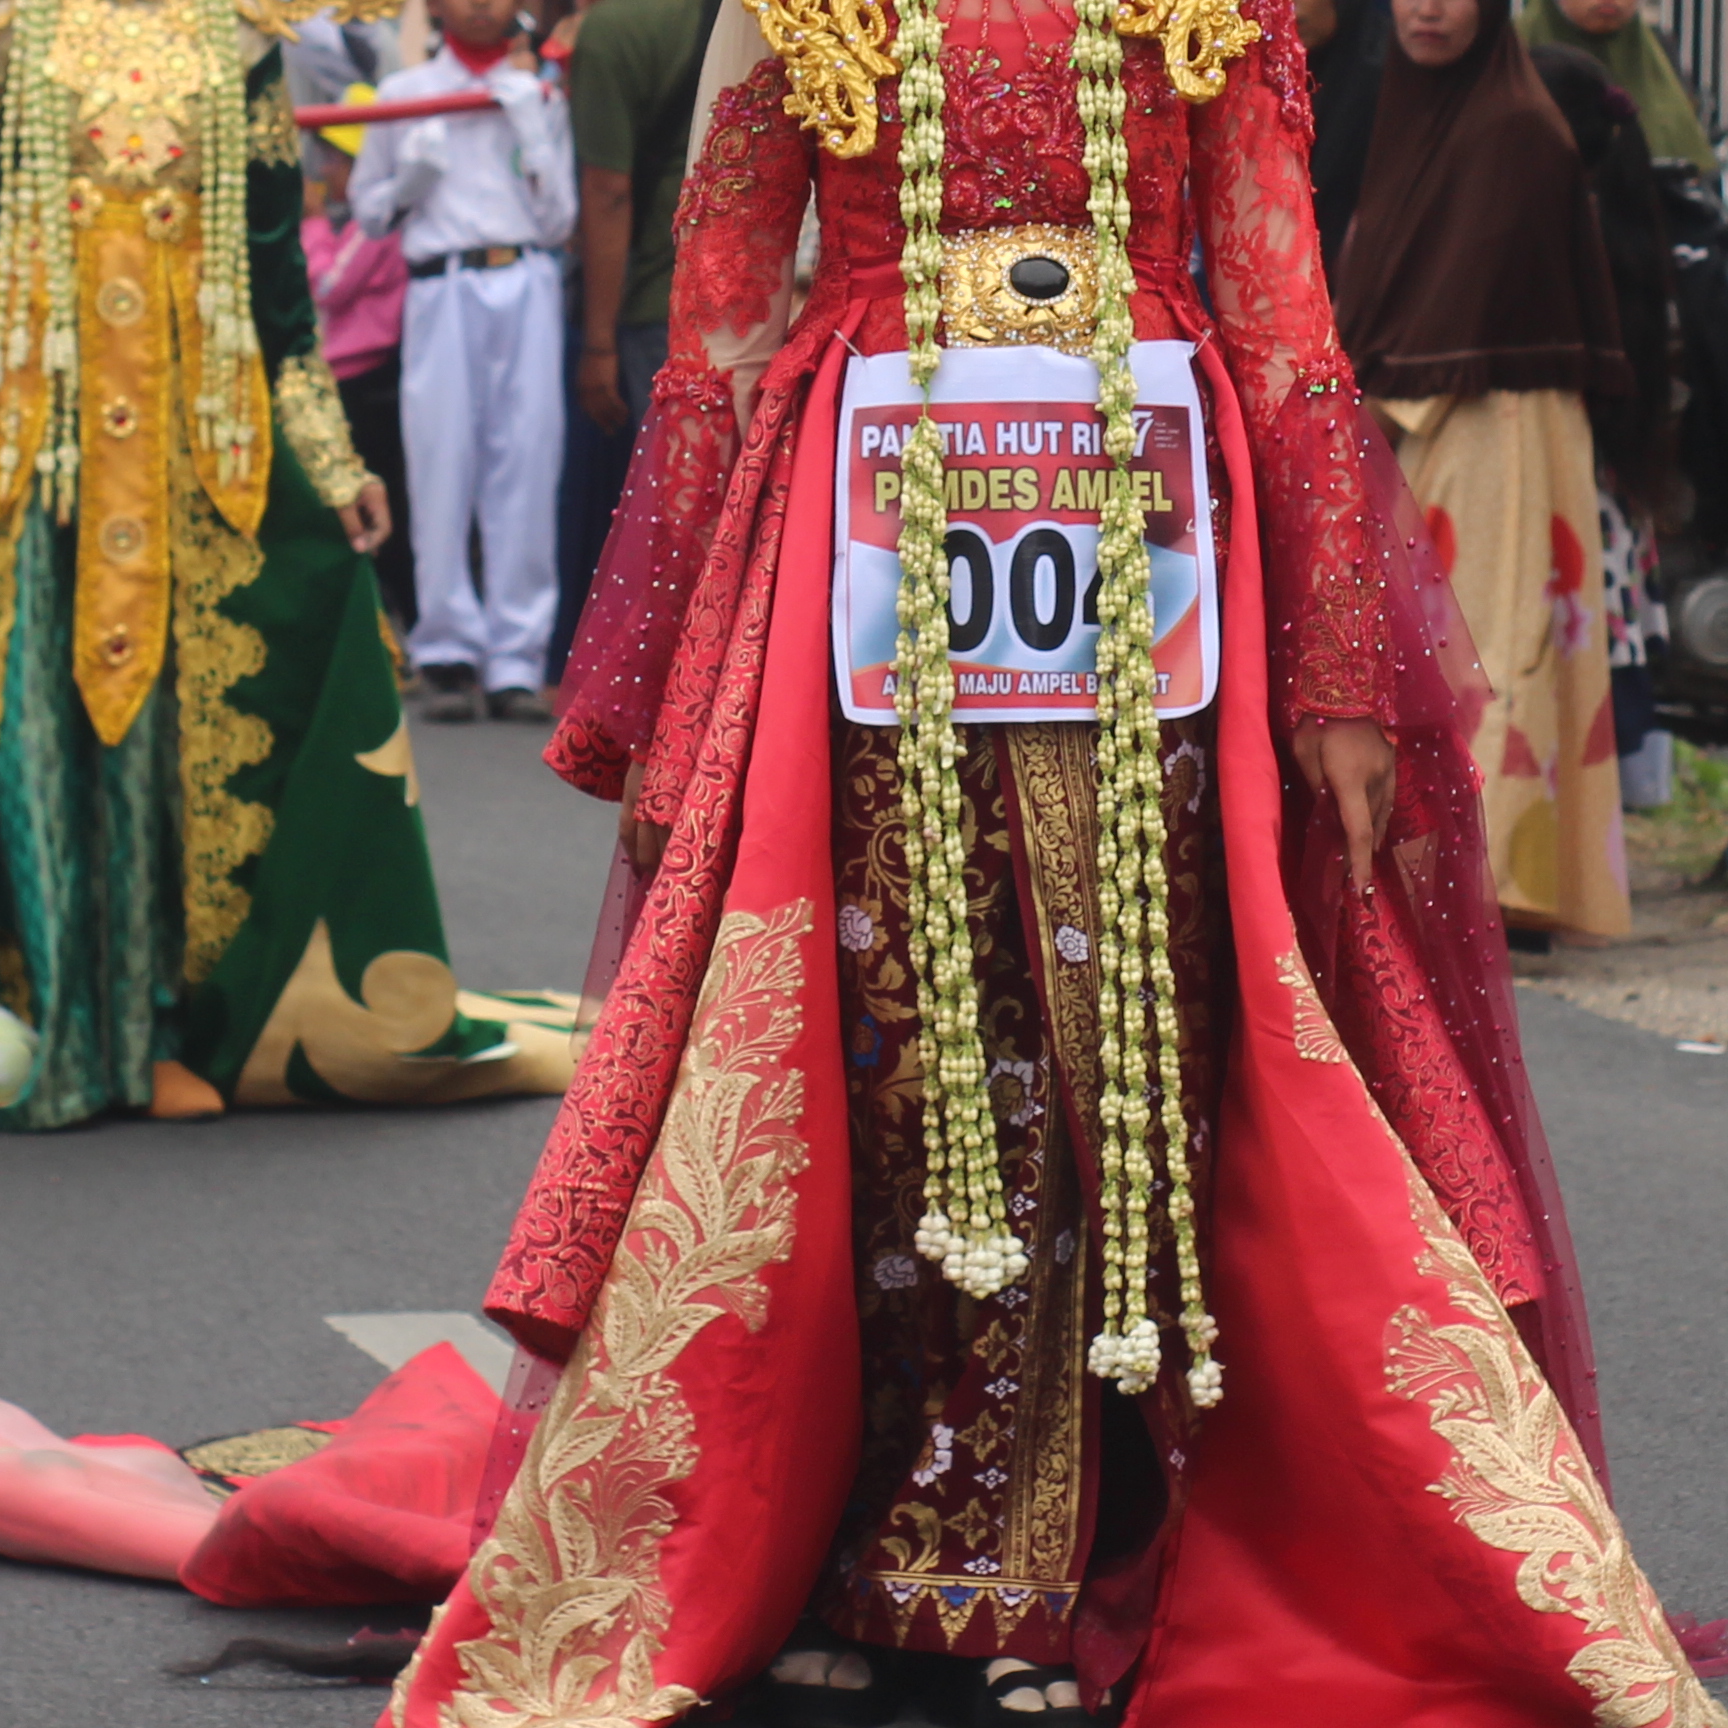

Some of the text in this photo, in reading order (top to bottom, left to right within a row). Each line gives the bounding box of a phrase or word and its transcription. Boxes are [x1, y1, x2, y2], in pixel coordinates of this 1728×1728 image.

[861, 421, 988, 459] PATIA
[996, 421, 1064, 456] HUT
[1072, 421, 1101, 456] RI
[958, 672, 1012, 695] MAJU
[1017, 673, 1082, 695] AMPEL
